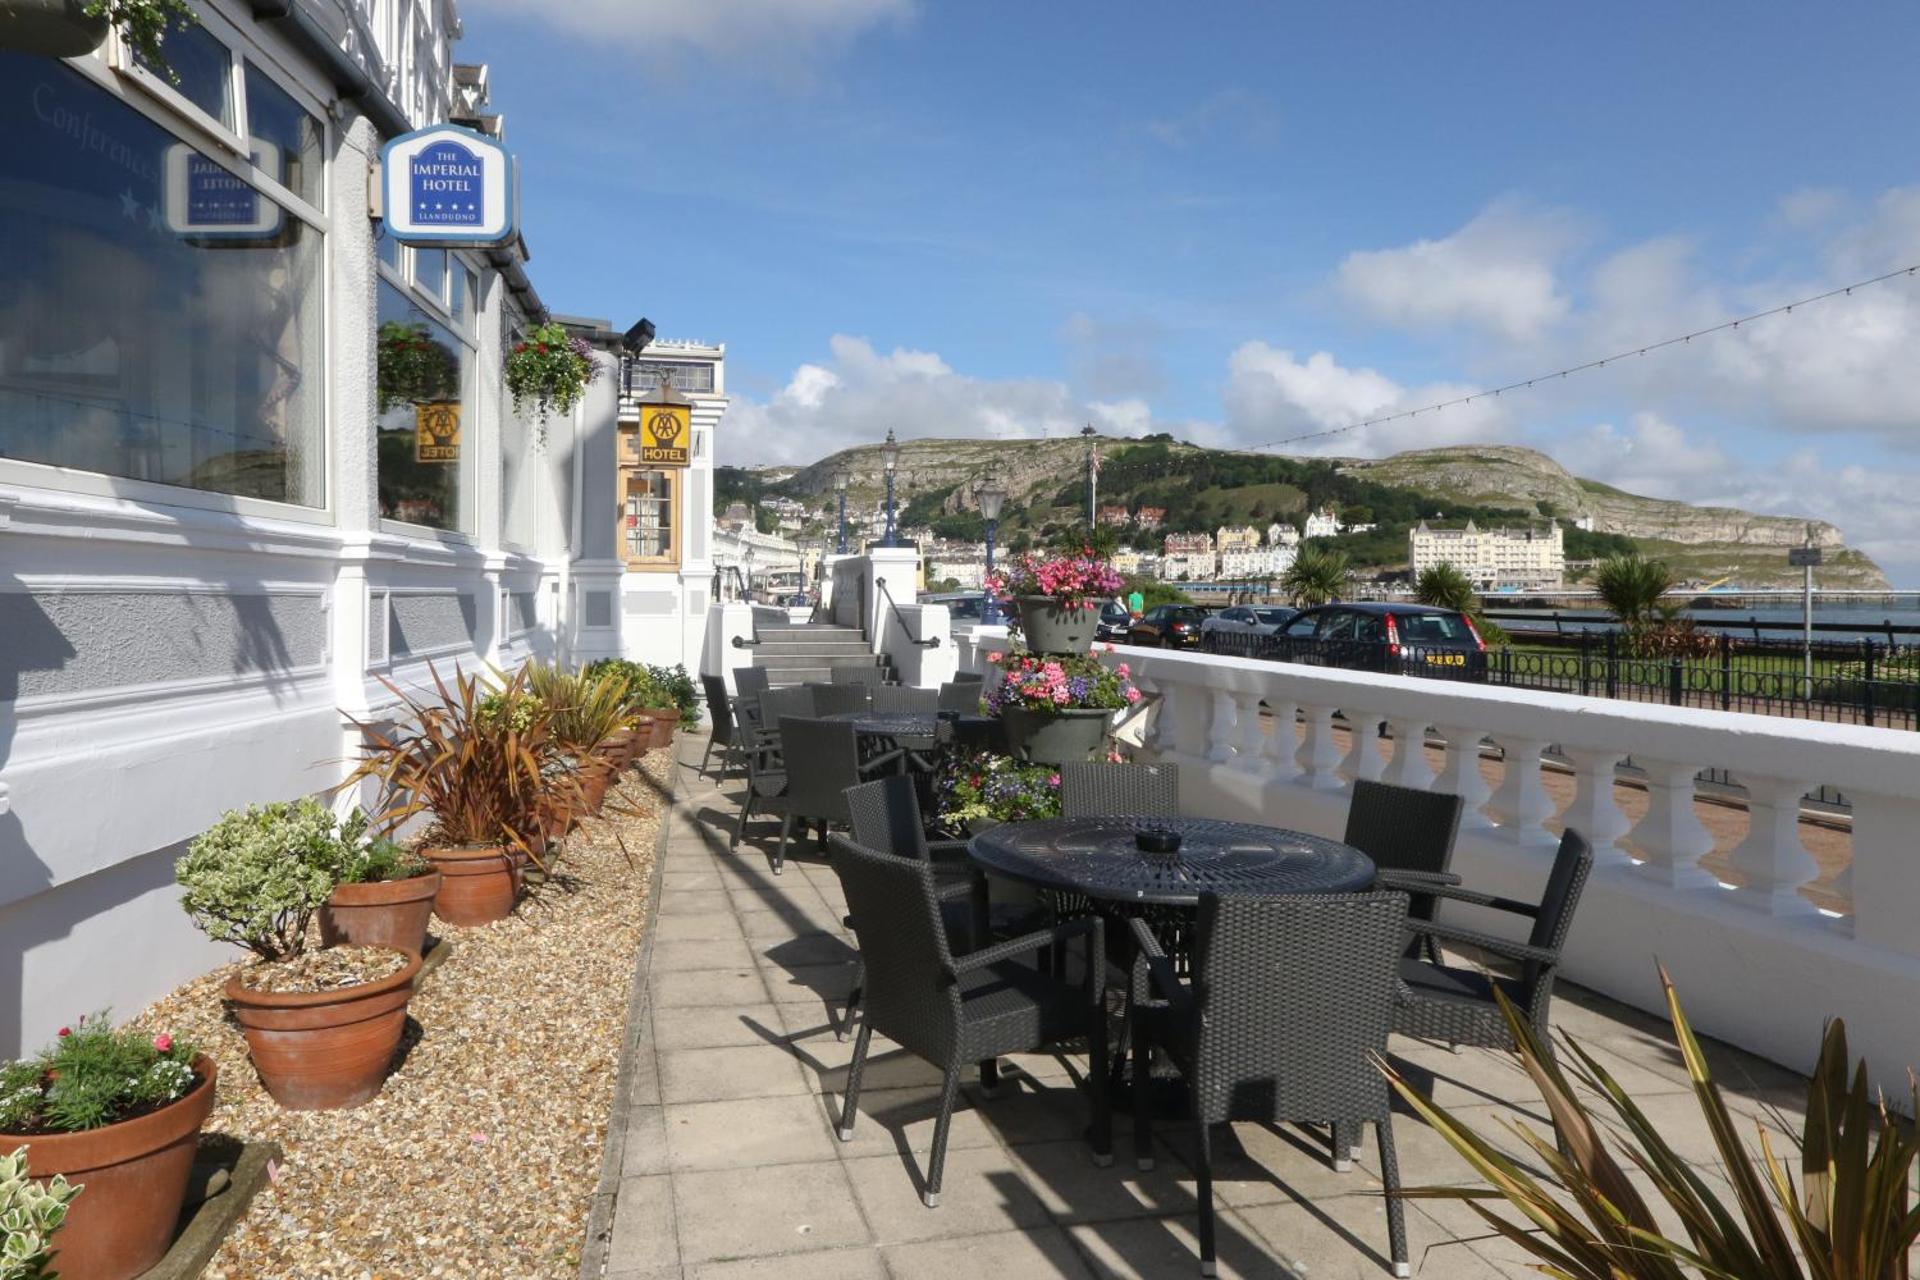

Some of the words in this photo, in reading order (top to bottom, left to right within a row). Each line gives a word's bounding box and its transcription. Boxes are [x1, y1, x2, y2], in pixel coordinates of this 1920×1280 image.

[437, 152, 457, 161] THE
[414, 164, 480, 176] IMPERIAL
[423, 180, 471, 191] HOTEL
[419, 212, 476, 221] LLANDUDNO
[656, 412, 675, 437] AA
[644, 448, 685, 460] HOTEL
